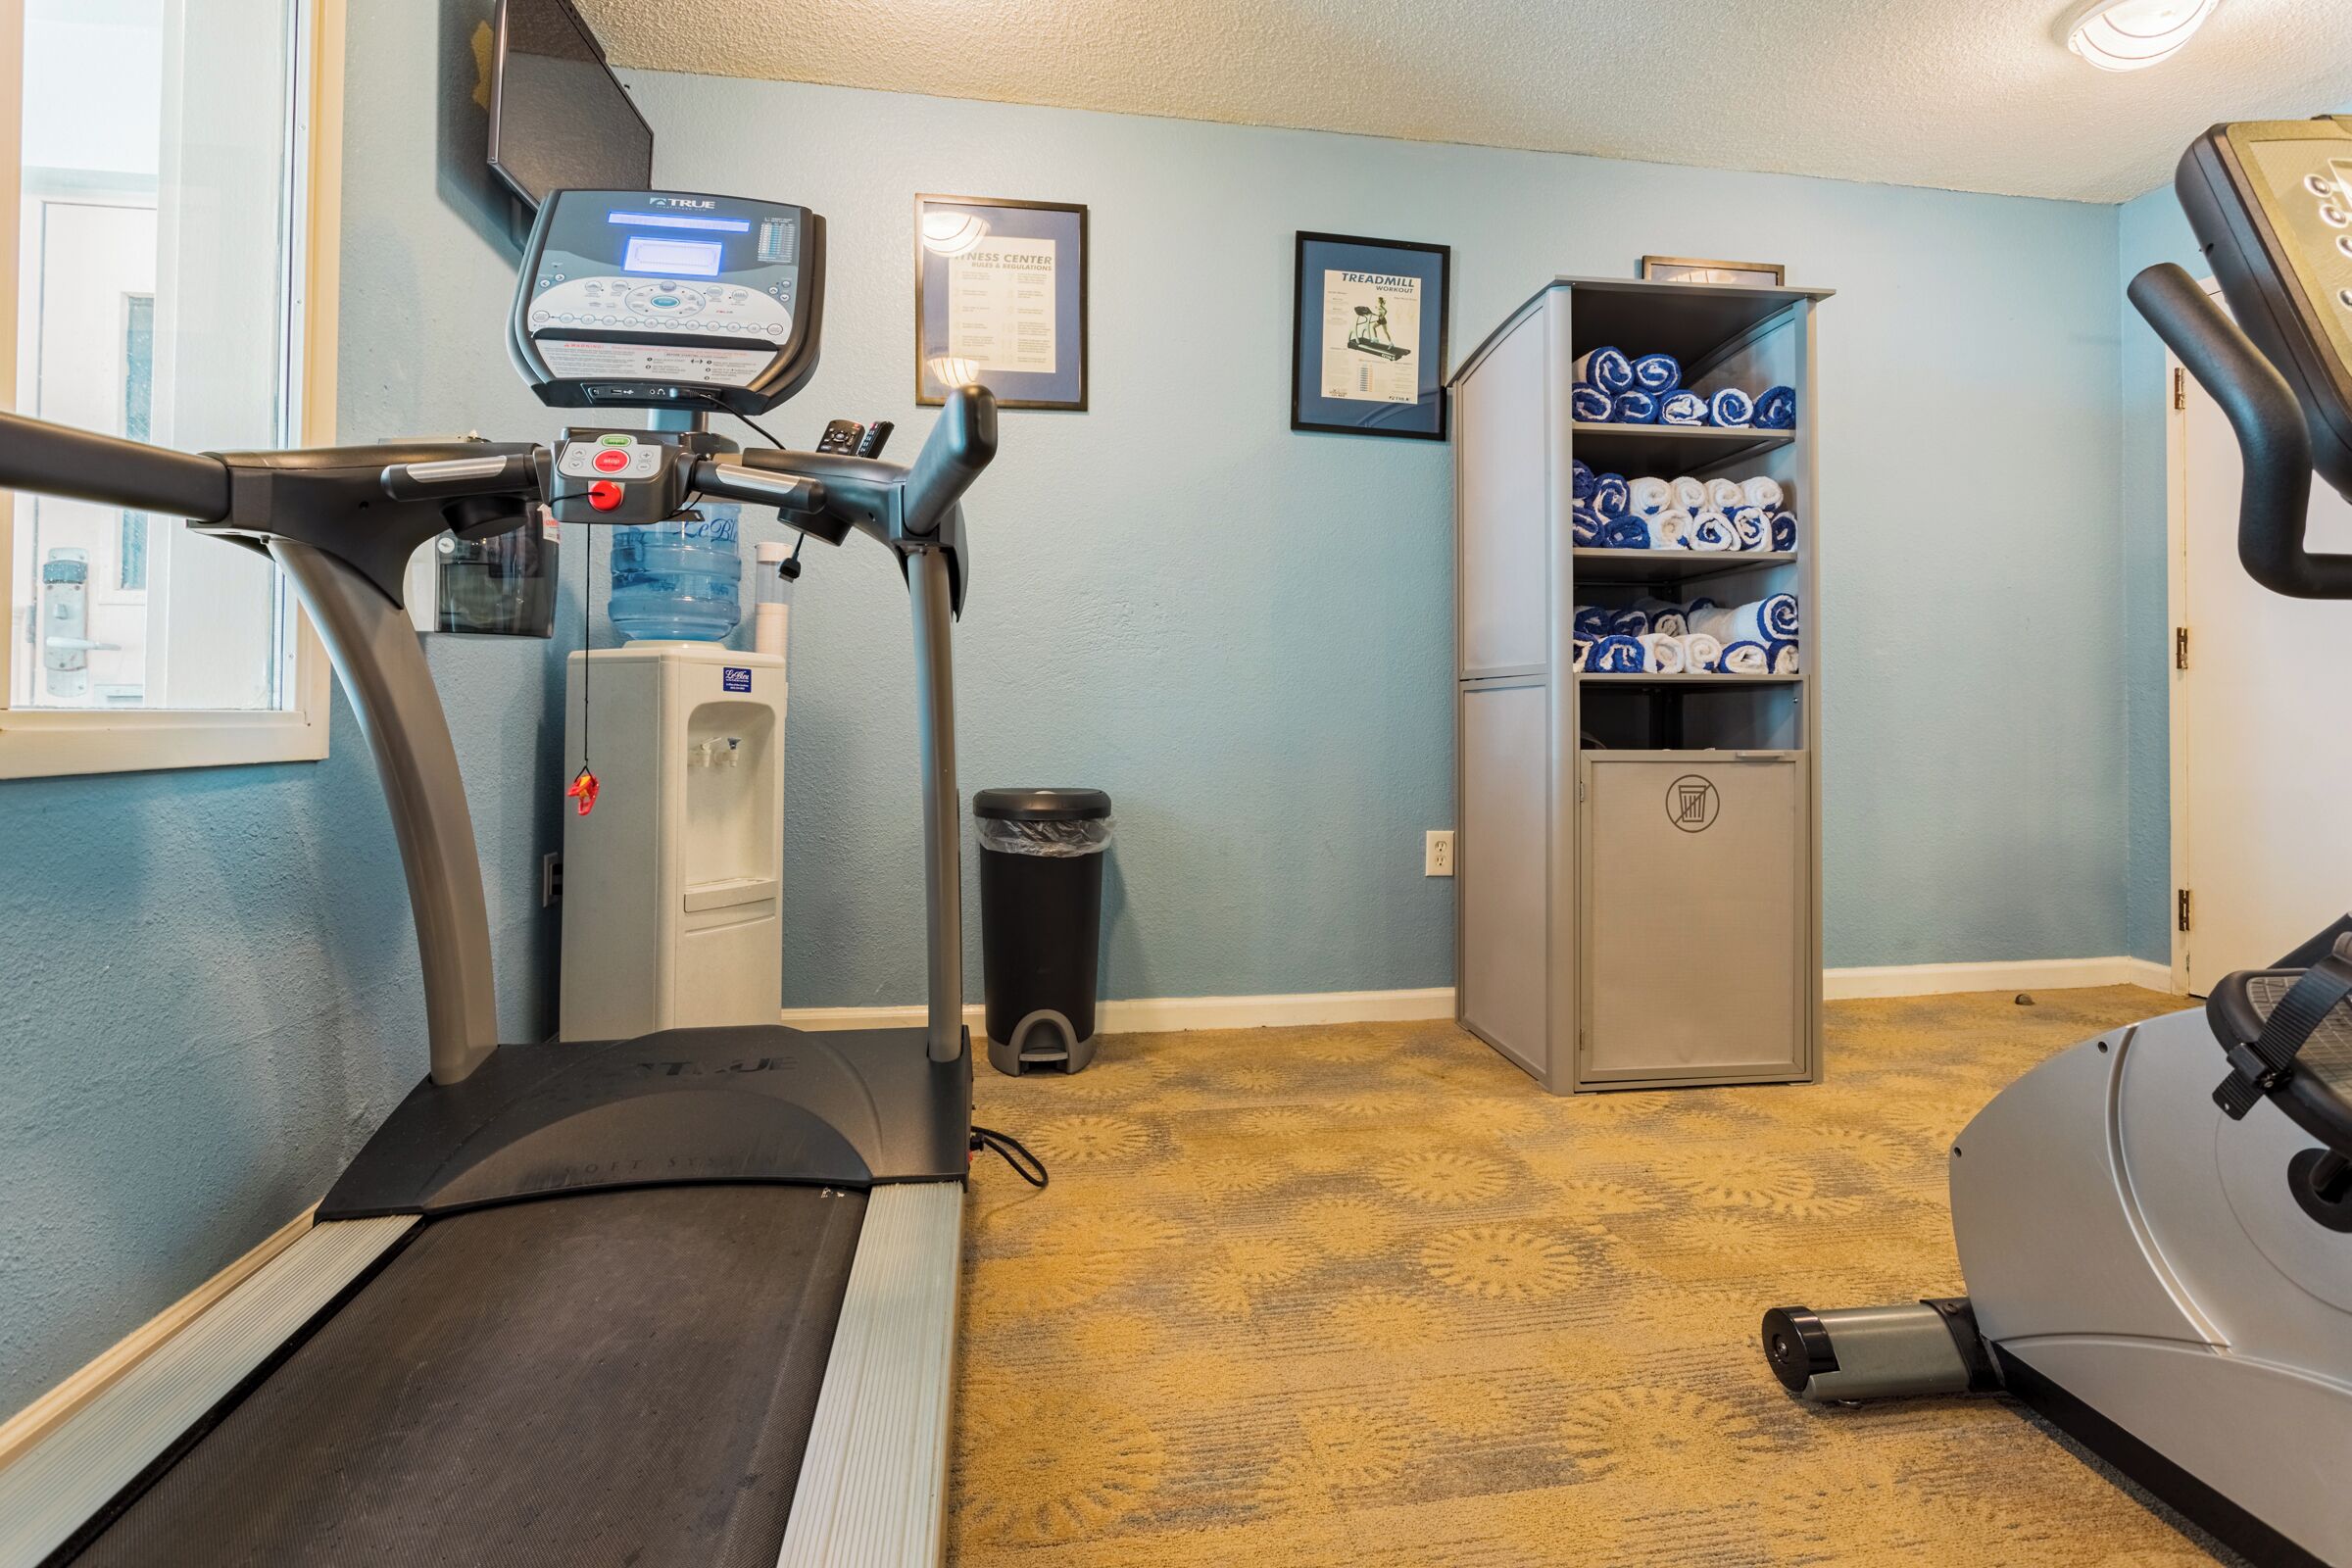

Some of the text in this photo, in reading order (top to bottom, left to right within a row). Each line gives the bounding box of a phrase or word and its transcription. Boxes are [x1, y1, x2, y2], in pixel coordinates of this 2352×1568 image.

[668, 198, 715, 210] TRUE
[955, 252, 1053, 265] TNESS CENTER
[1002, 263, 1053, 271] REGULATIONS
[1342, 272, 1414, 287] TREADMILL
[1376, 285, 1414, 294] WORKOUT
[660, 1056, 799, 1076] TUE
